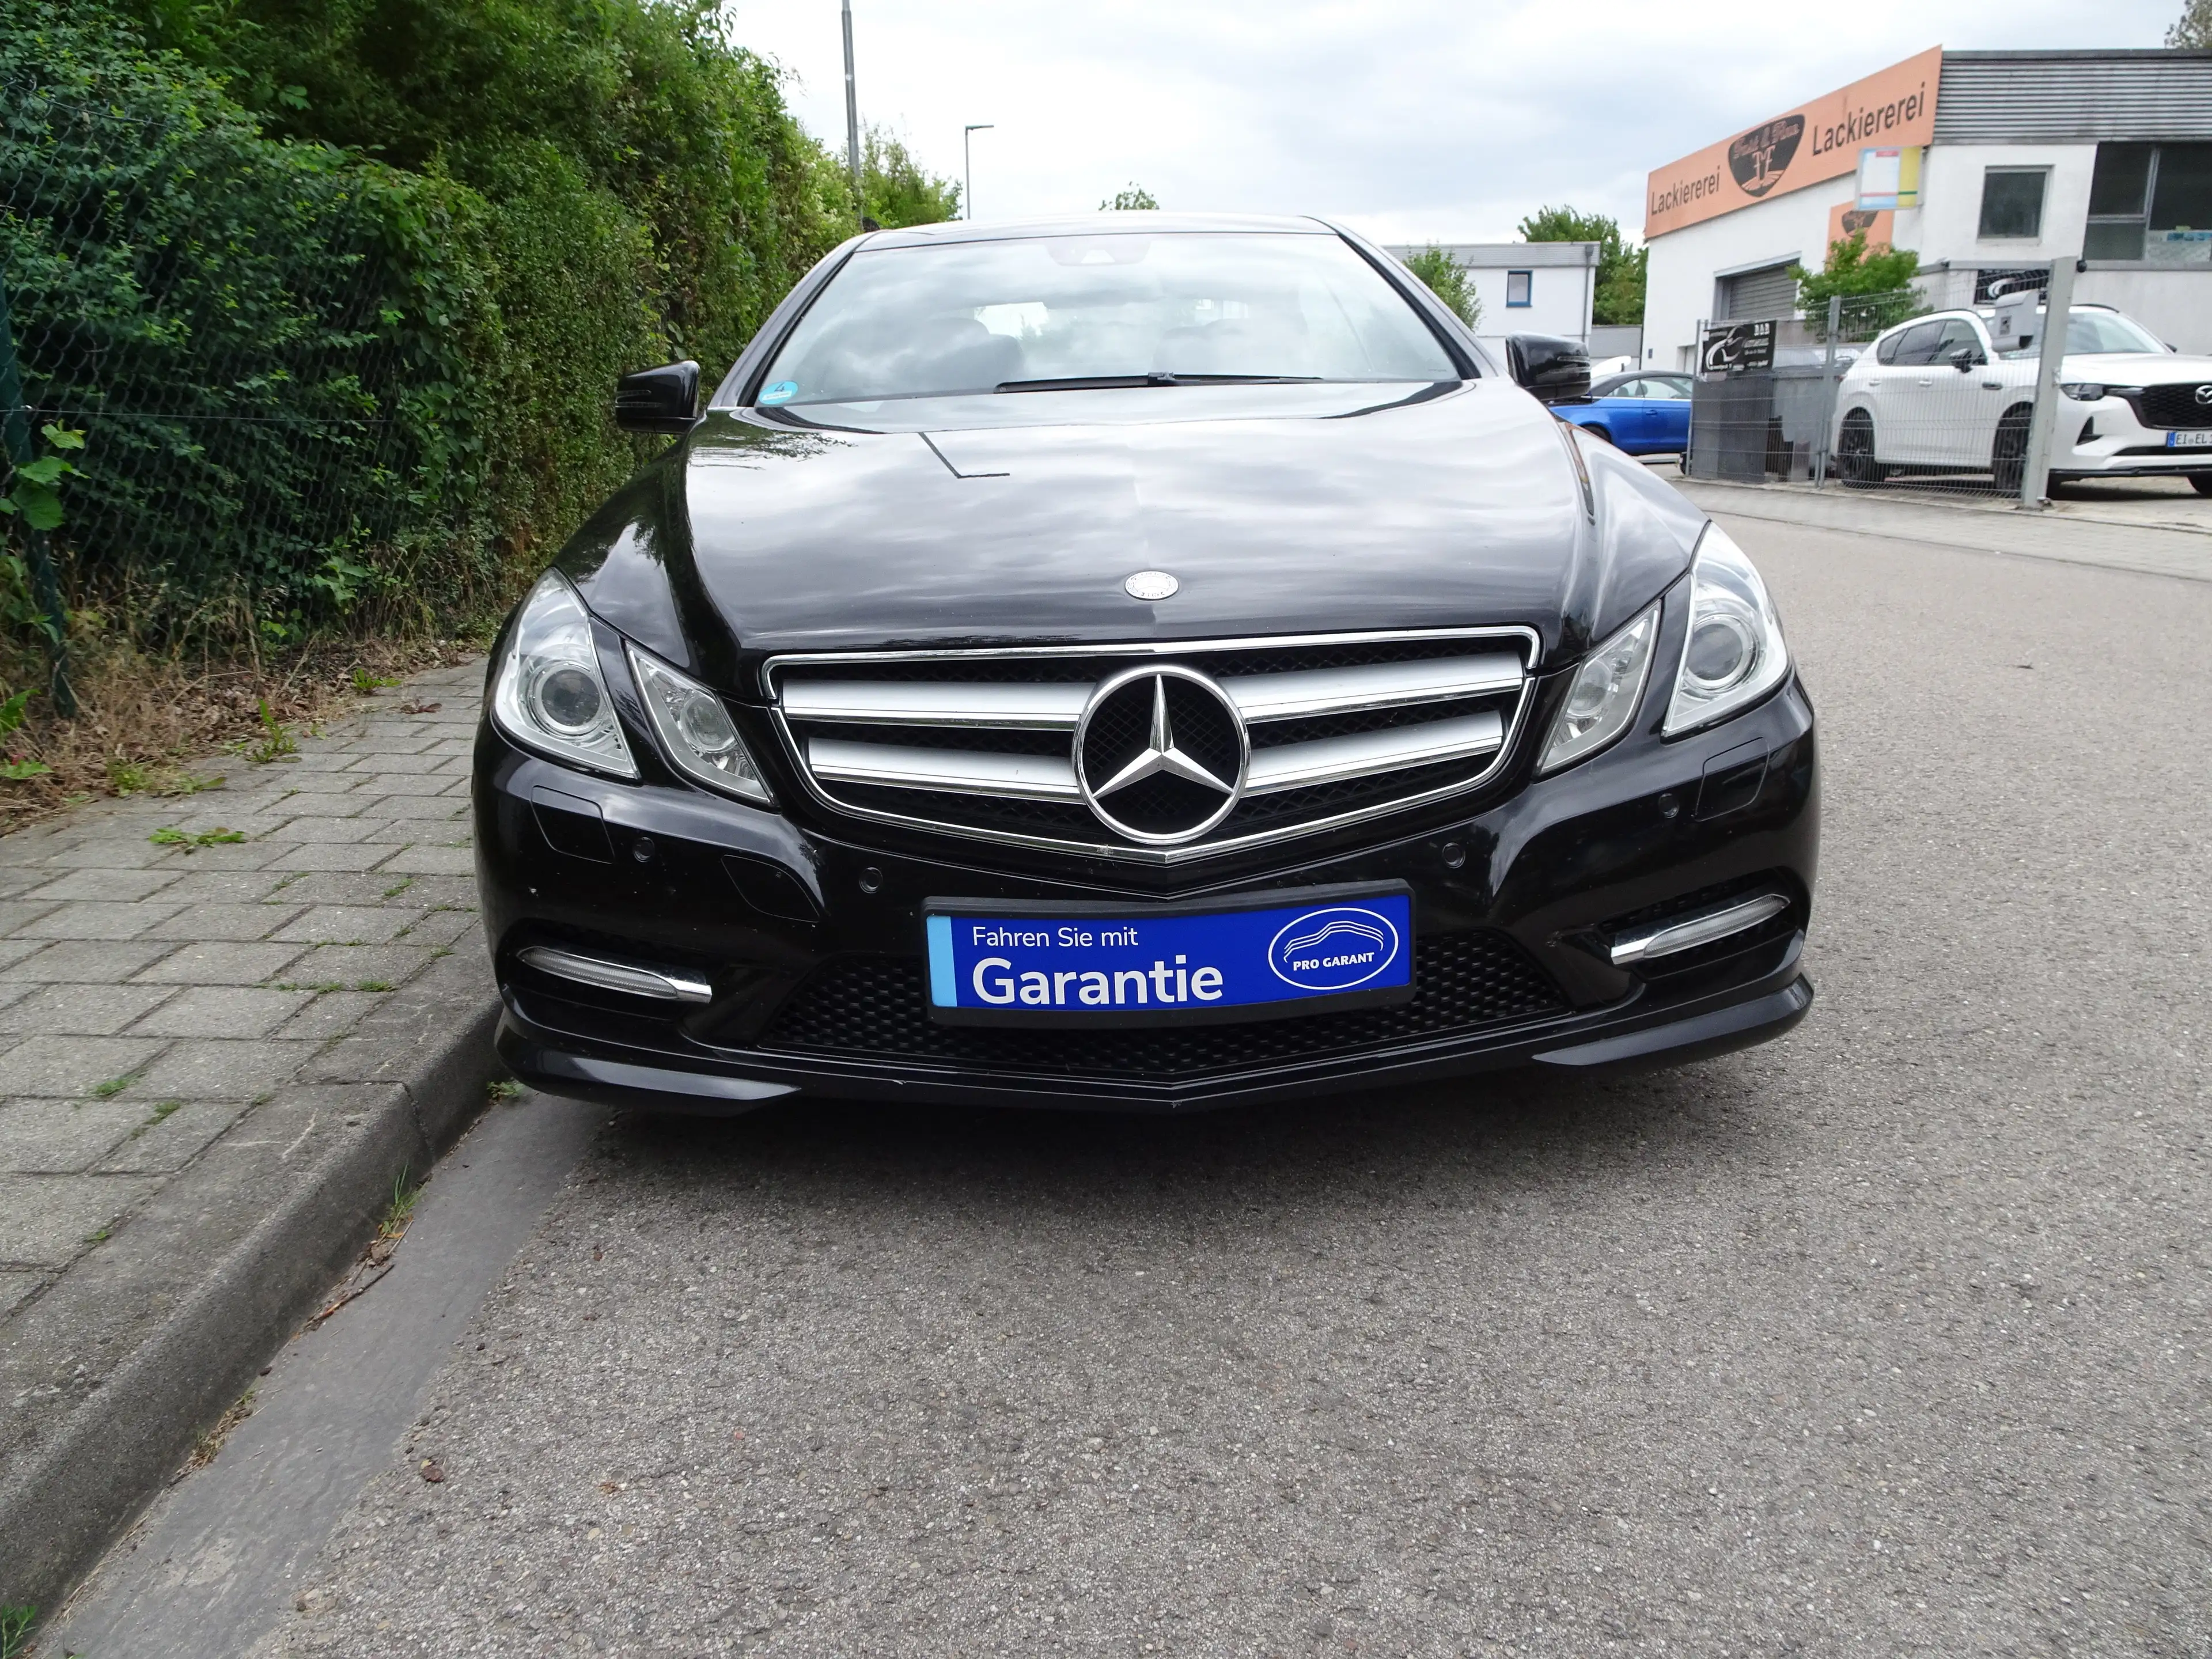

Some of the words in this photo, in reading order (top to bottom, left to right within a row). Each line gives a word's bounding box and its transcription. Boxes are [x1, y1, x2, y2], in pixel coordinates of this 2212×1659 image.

[1813, 81, 1925, 156] Lackiererei
[1652, 165, 1720, 215] Lackiererei
[774, 382, 785, 392] 4
[973, 926, 1050, 946] Fahren
[1058, 926, 1093, 946] Sie
[1101, 926, 1139, 946] mit
[1293, 959, 1320, 971] PRO
[1322, 952, 1374, 968] GARANT
[972, 955, 1223, 1005] Garantie
